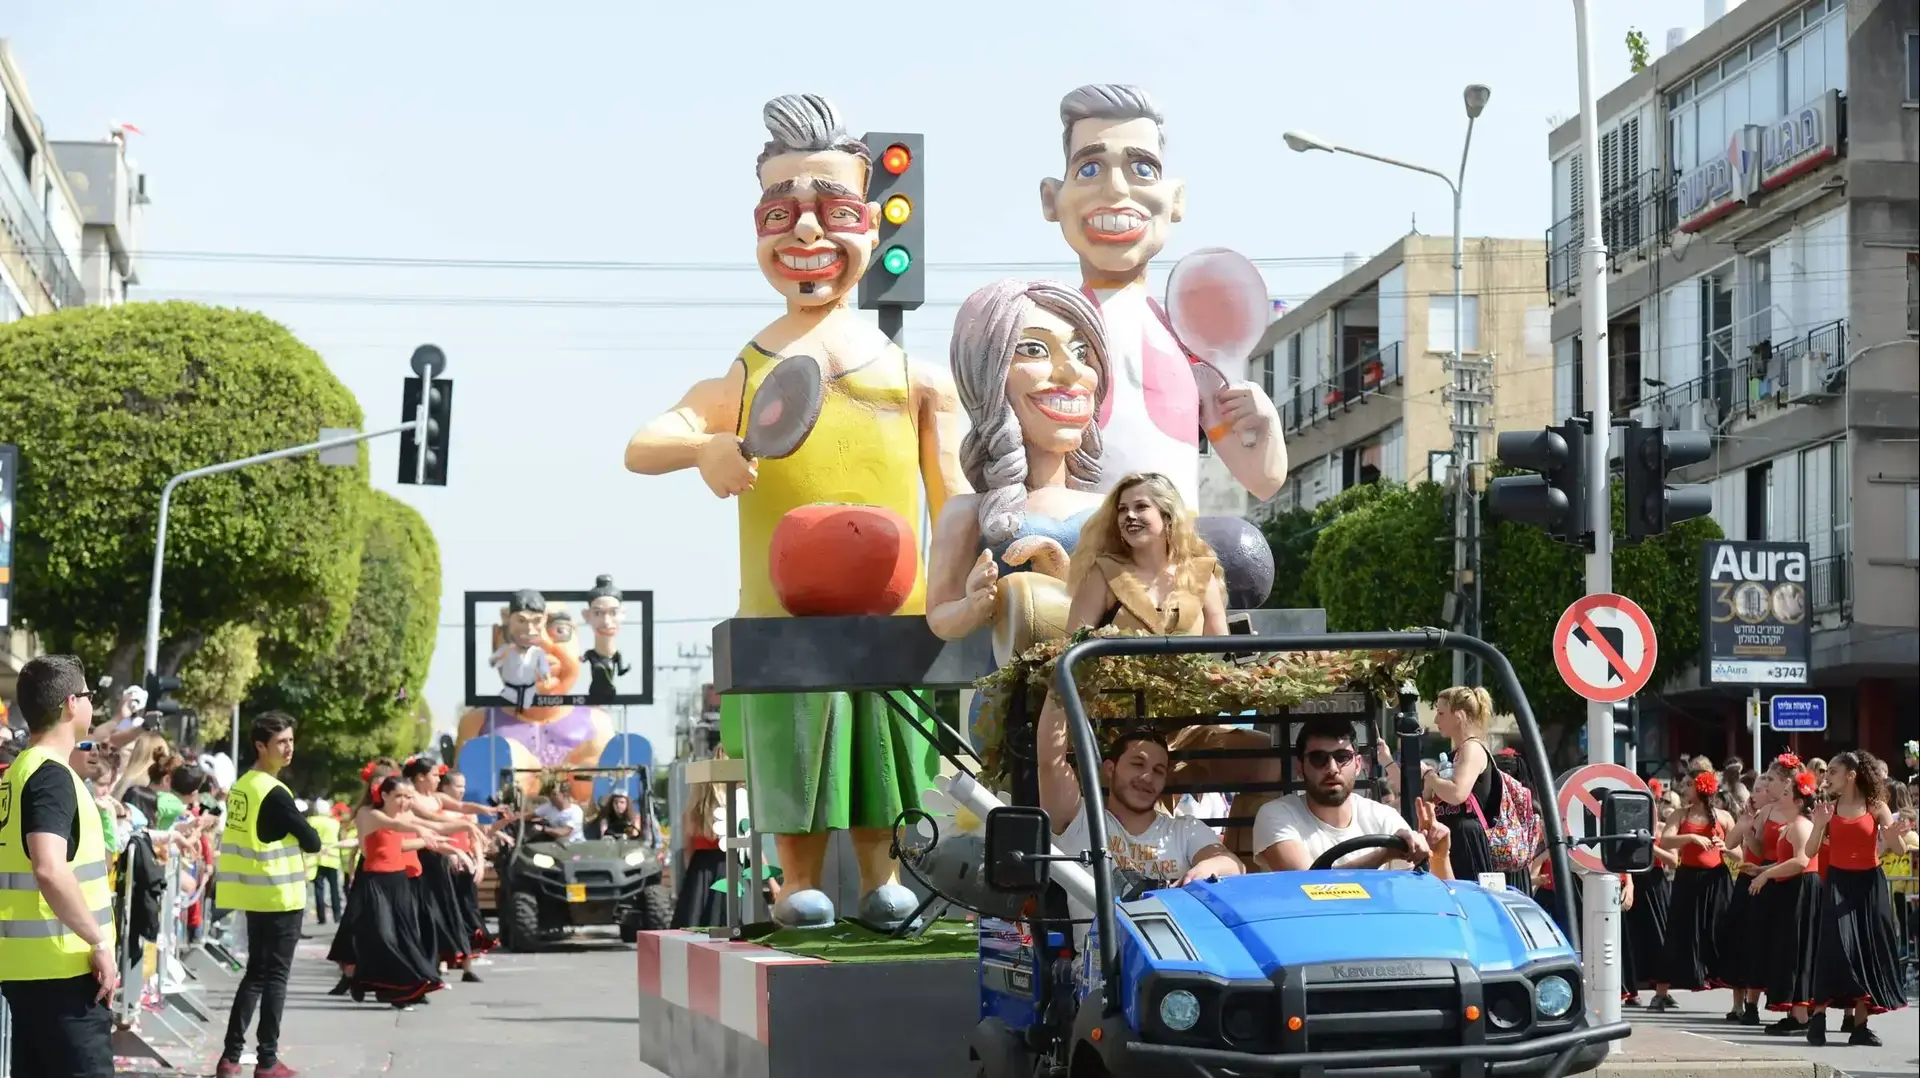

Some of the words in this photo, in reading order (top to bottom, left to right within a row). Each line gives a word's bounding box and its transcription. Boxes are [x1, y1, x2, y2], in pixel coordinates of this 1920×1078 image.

[1710, 545, 1806, 582] Aura
[1710, 582, 1806, 624] 300
[1727, 666, 1747, 674] Aura
[1130, 844, 1158, 861] THE
[1151, 859, 1178, 875] ARE
[1331, 961, 1426, 979] Kawasaki
